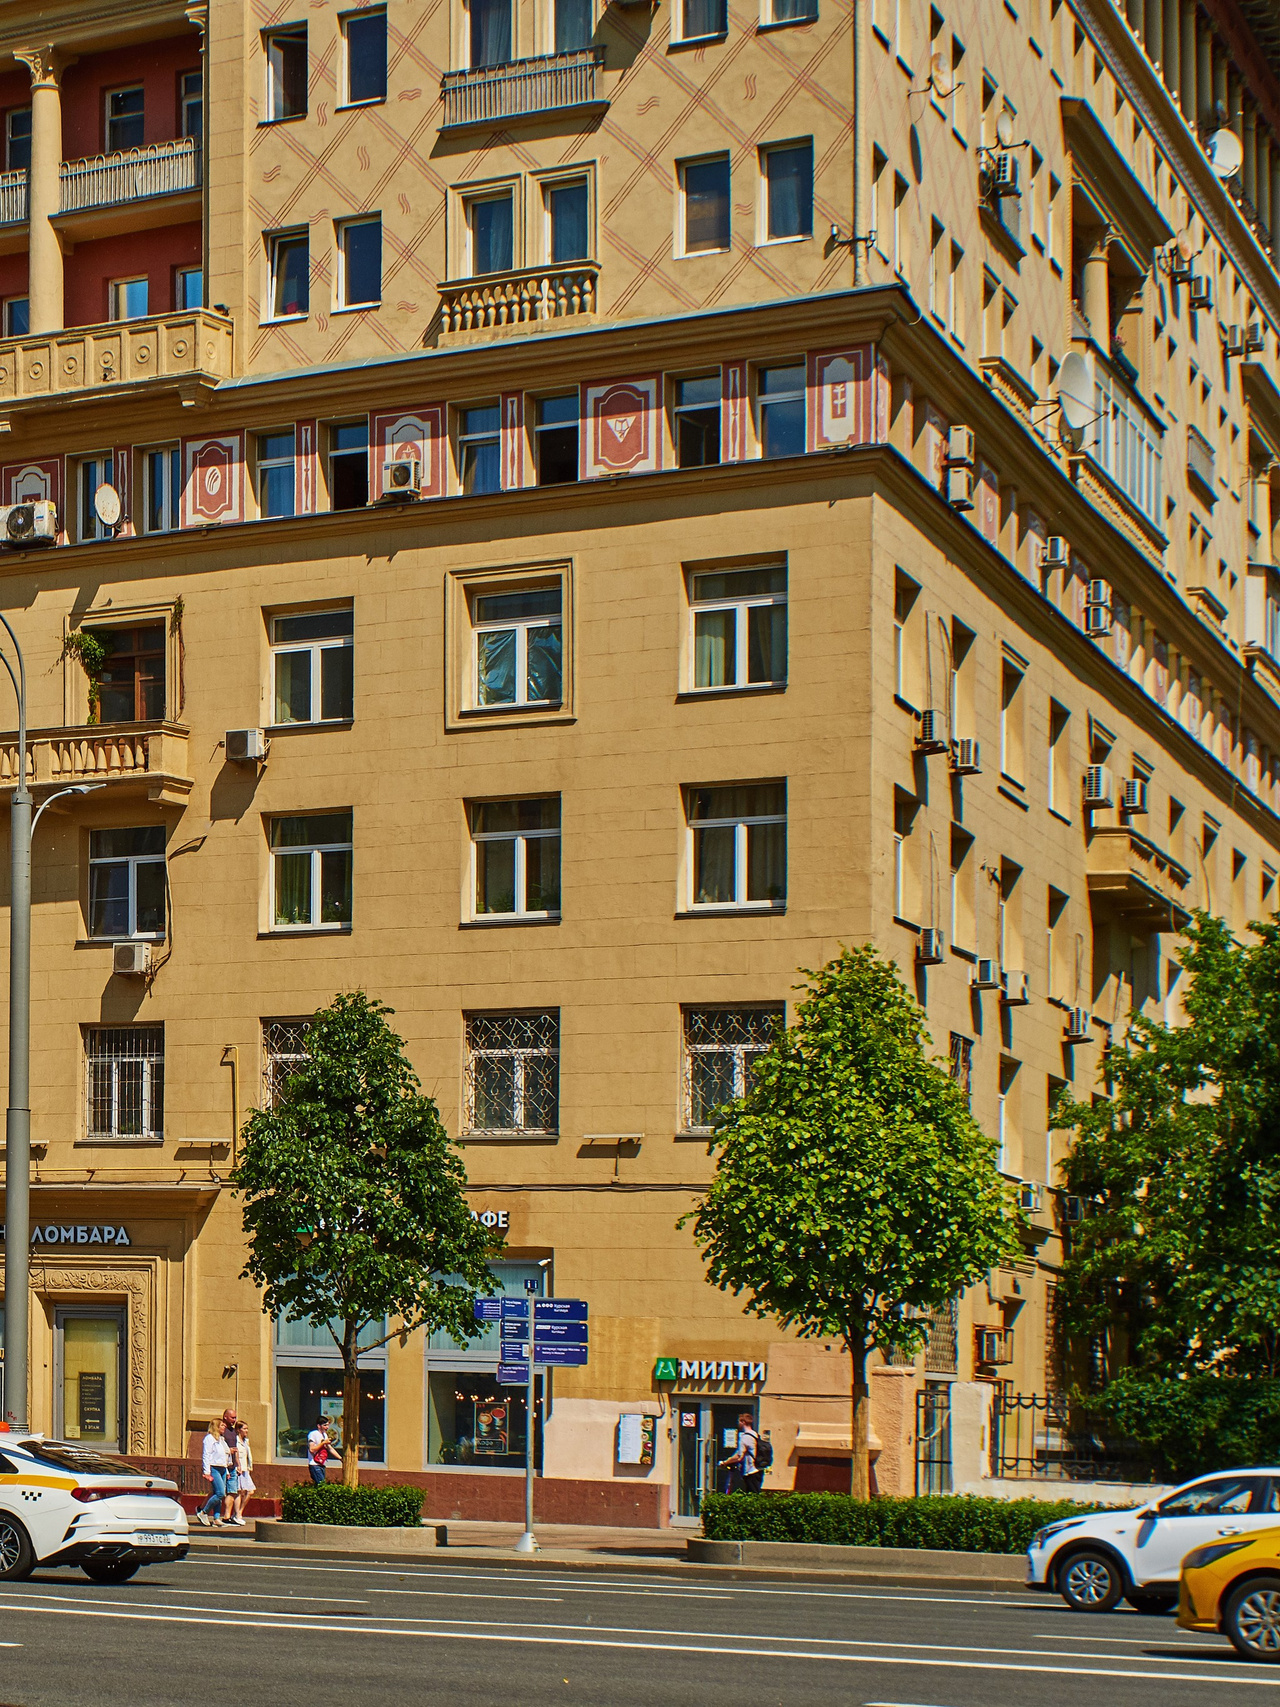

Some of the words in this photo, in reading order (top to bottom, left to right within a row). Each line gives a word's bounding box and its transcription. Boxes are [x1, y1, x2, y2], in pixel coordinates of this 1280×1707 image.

[470, 1210, 508, 1228] АФЕ
[30, 1225, 130, 1246] ЛОМБАРД
[681, 1360, 766, 1380] МИЛТИ
